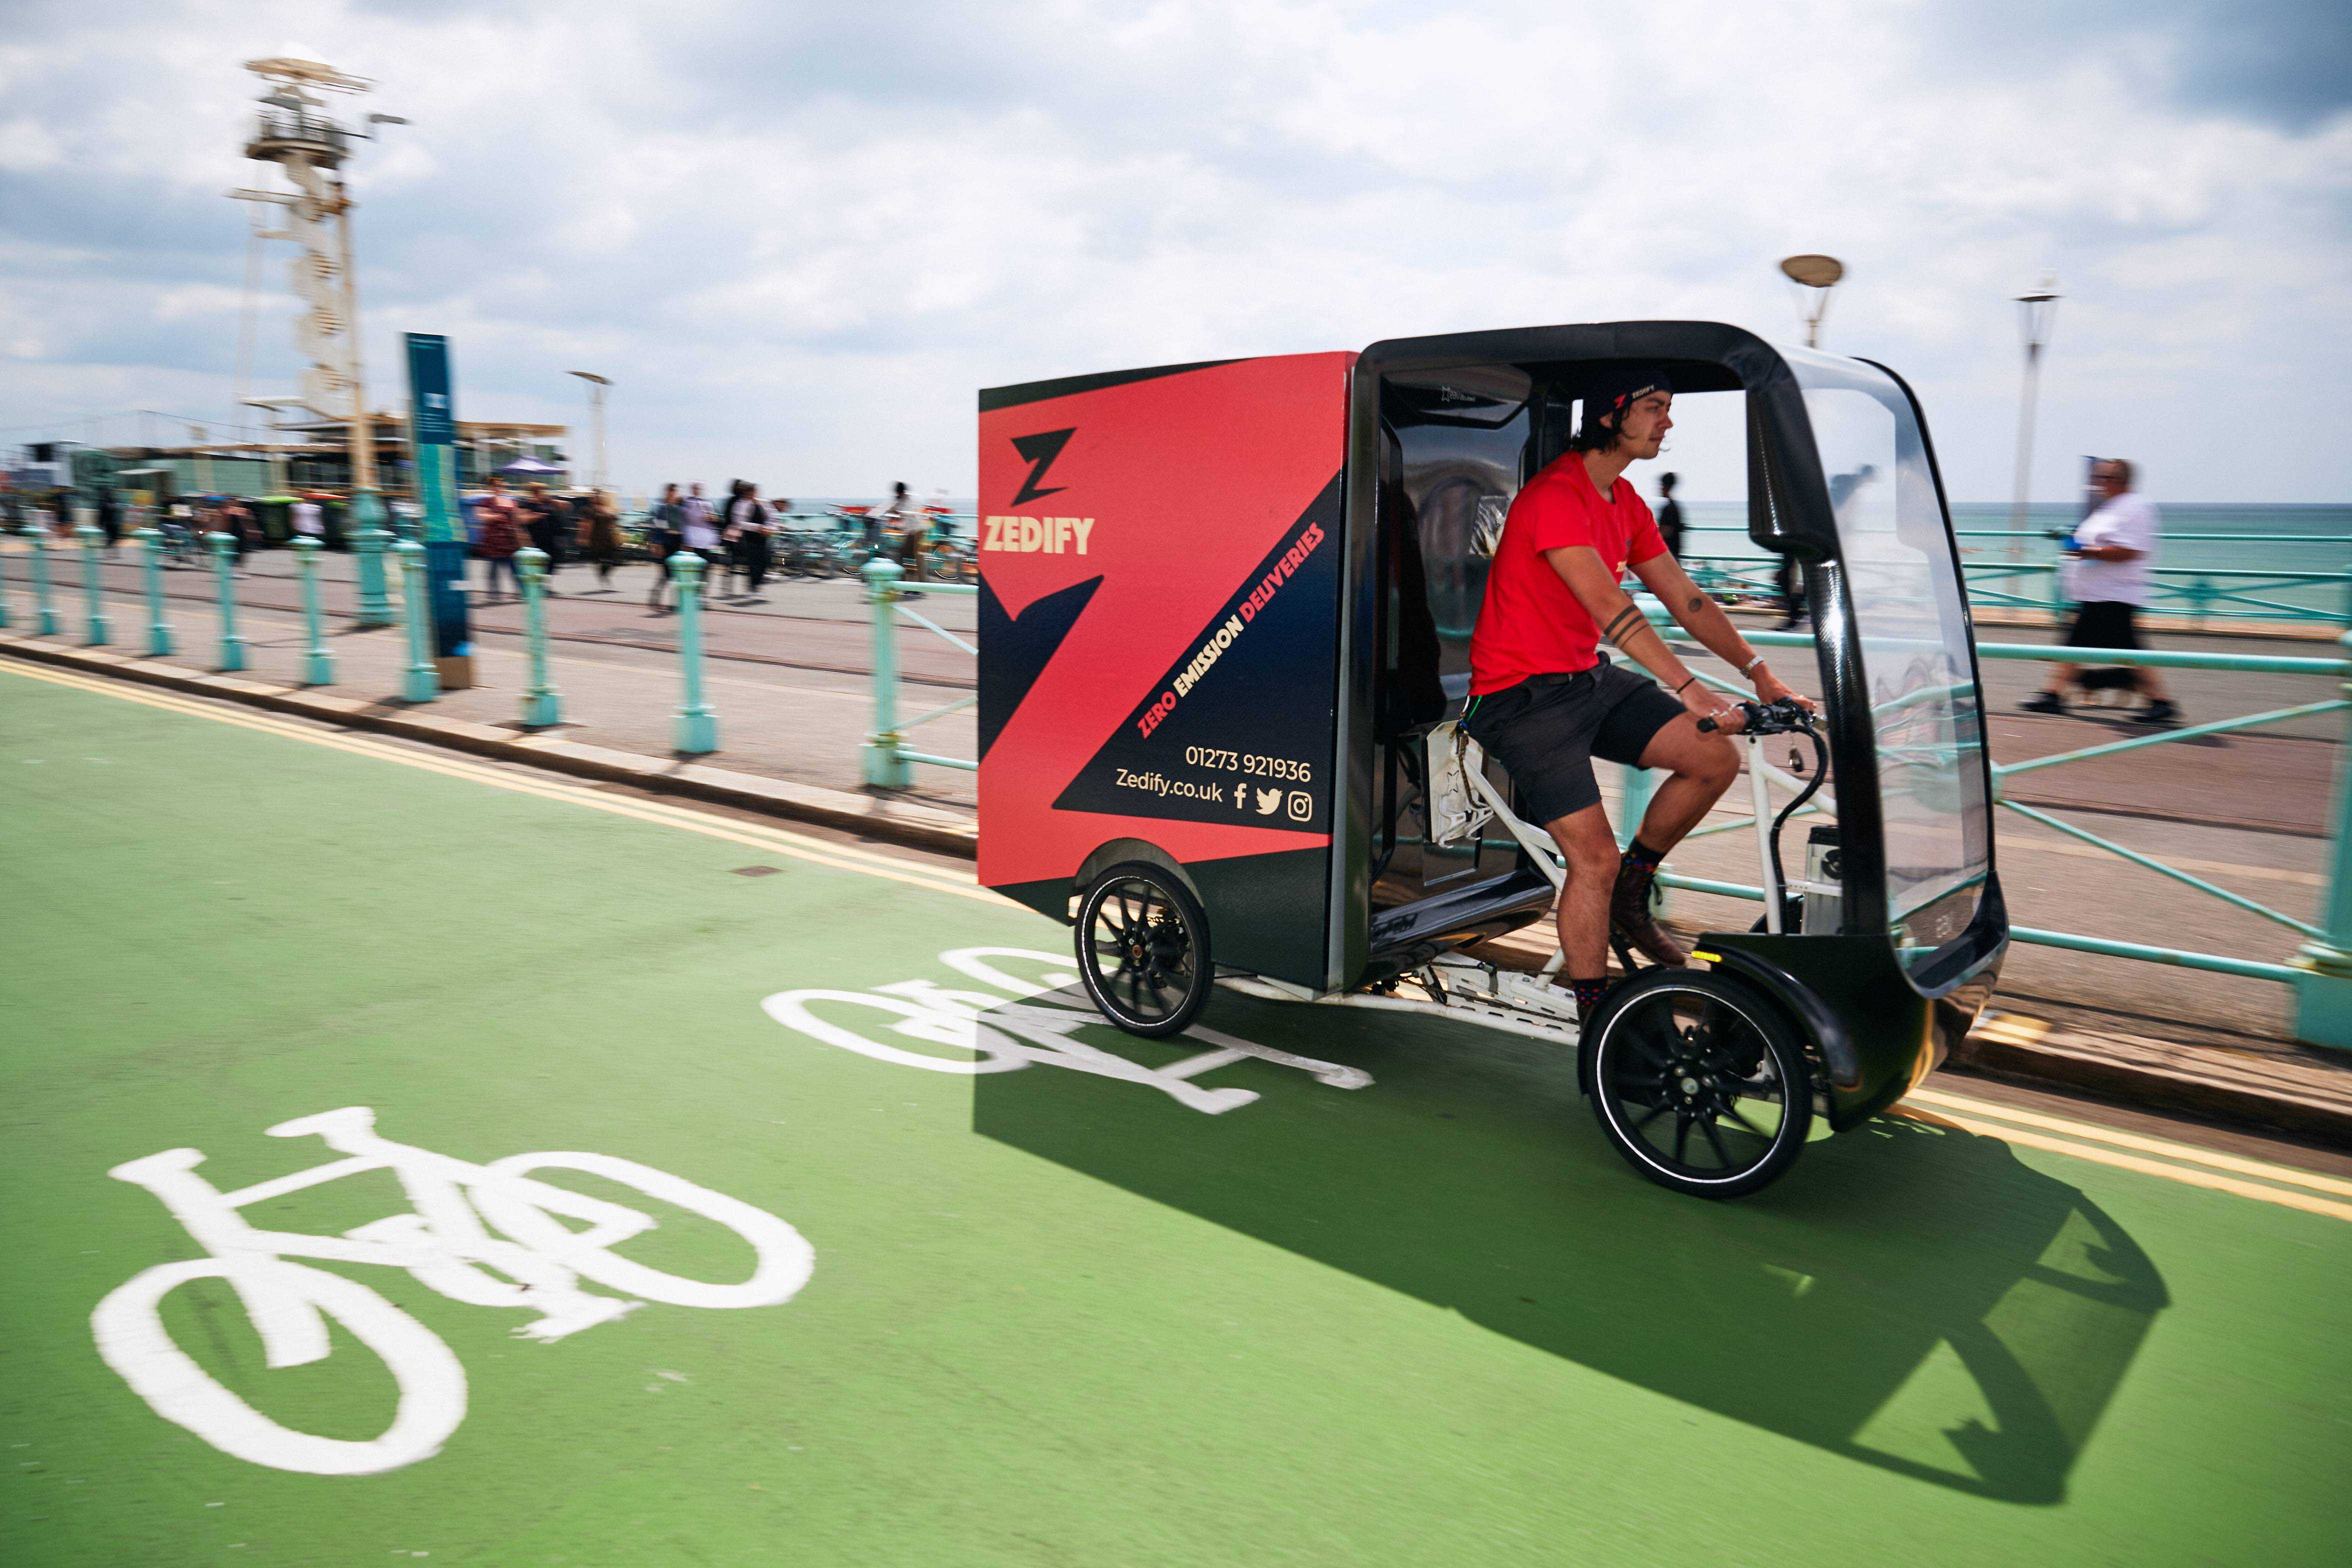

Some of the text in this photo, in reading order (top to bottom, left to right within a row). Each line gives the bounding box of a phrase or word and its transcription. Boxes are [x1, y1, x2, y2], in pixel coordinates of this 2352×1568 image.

[983, 516, 1095, 555] ZEDIFY
[1138, 521, 1324, 739] ZERO EMISSION DELIVERIES
[1186, 746, 1311, 782] 01273 921936
[1116, 768, 1223, 802] Zedify.co.uk
